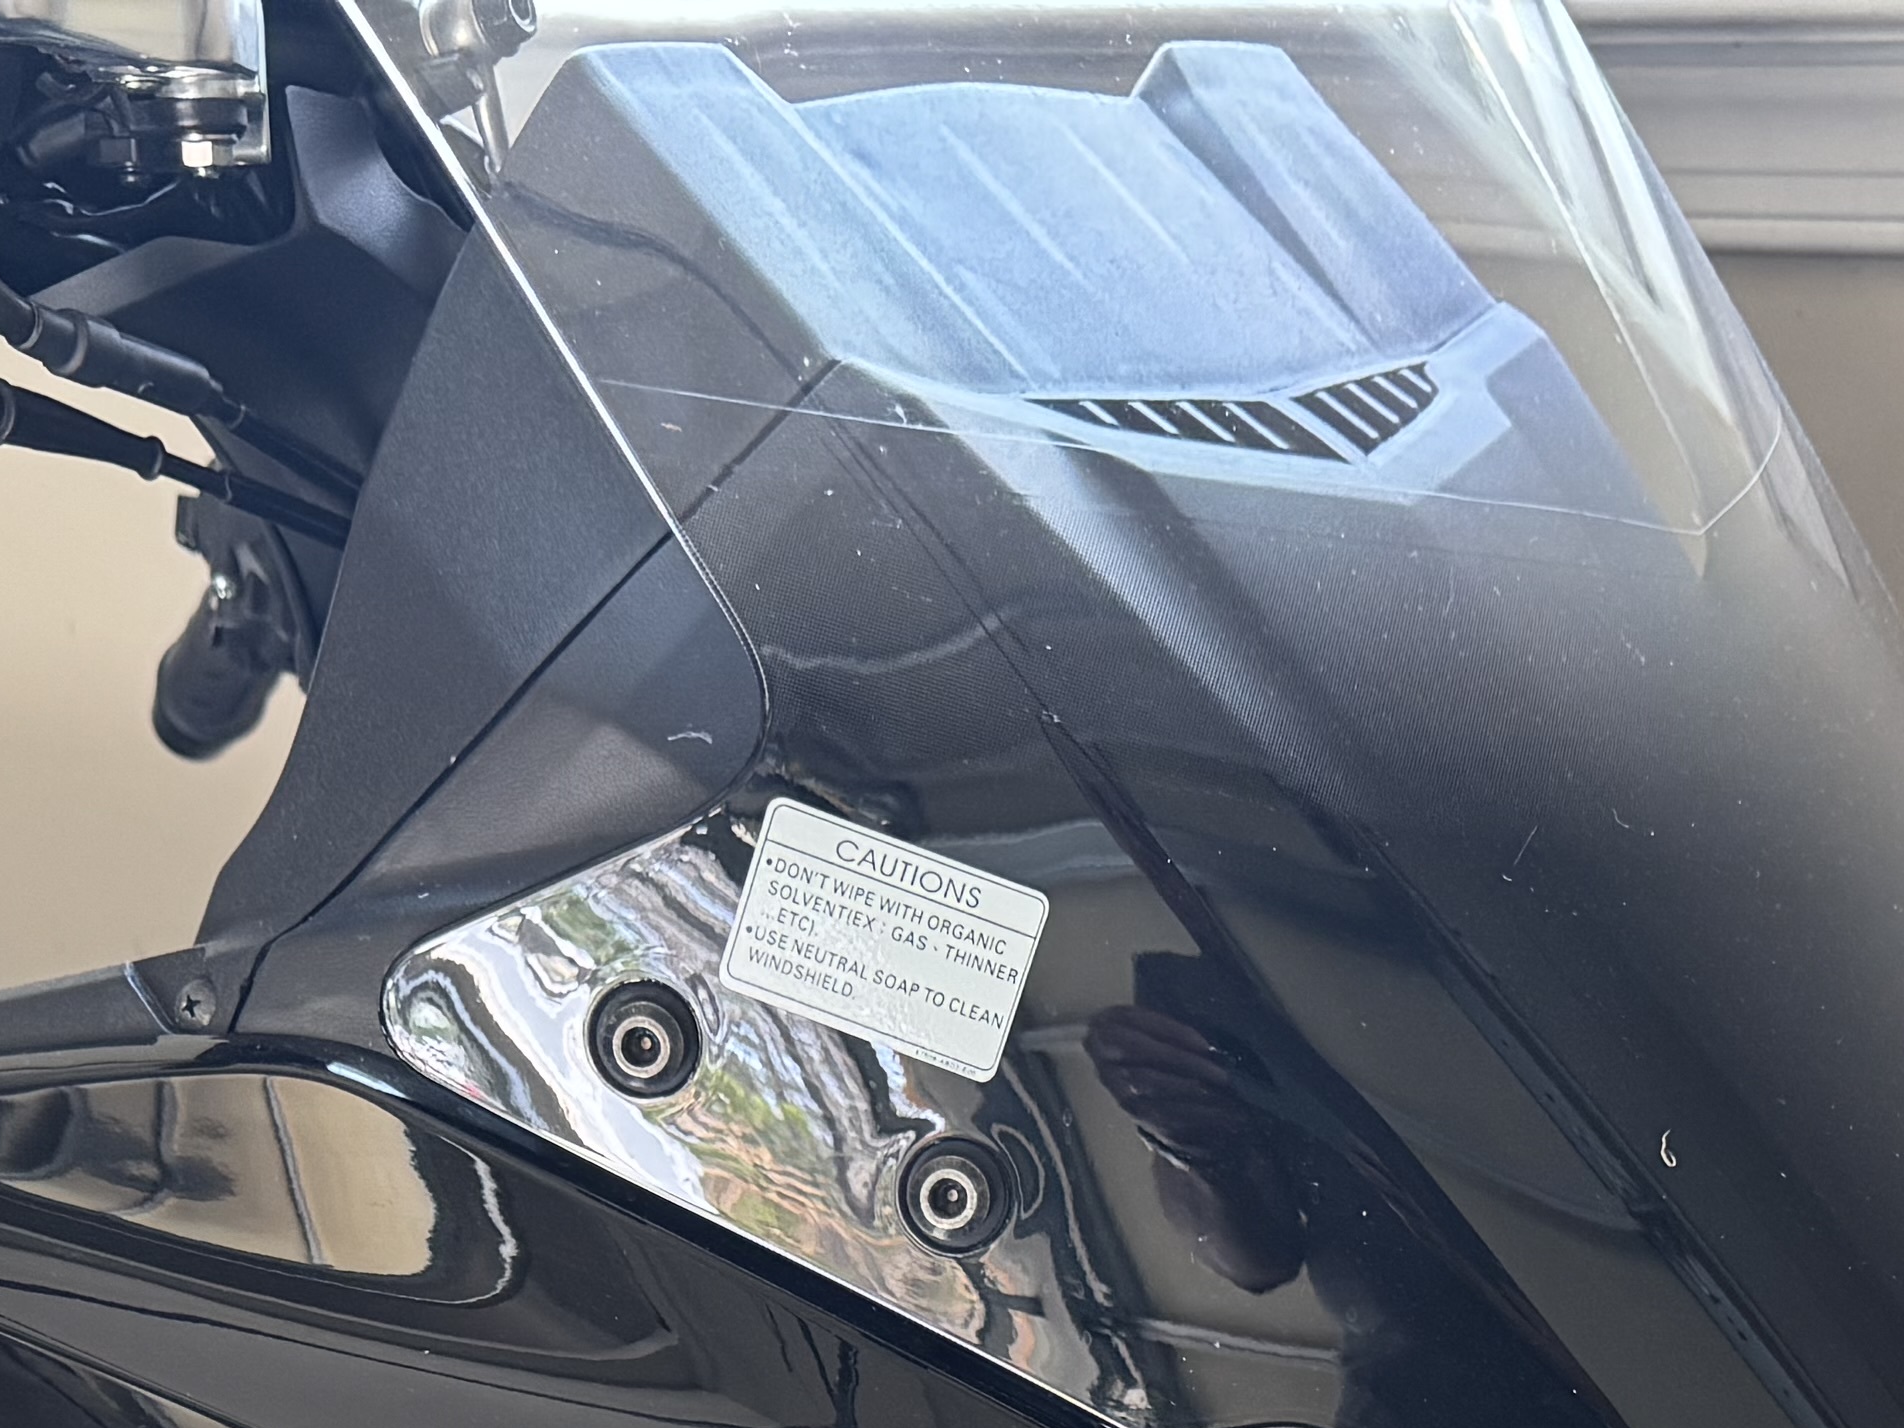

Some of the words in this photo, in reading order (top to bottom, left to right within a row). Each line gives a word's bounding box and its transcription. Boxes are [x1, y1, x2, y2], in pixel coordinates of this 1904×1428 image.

[835, 839, 981, 908] CAUTIONS
[833, 877, 876, 907] WIPE
[879, 895, 924, 925] WITH
[926, 914, 1006, 955] ORGANIC
[749, 946, 855, 999] WINDSHIELD.
[754, 926, 788, 950] USE
[790, 939, 867, 980] NEUTRAL
[872, 969, 920, 996] SOAP
[924, 986, 945, 1007] TO
[948, 997, 1004, 1029] CLEAN
[890, 925, 928, 950] GAS
[945, 943, 1018, 984] THINNER
